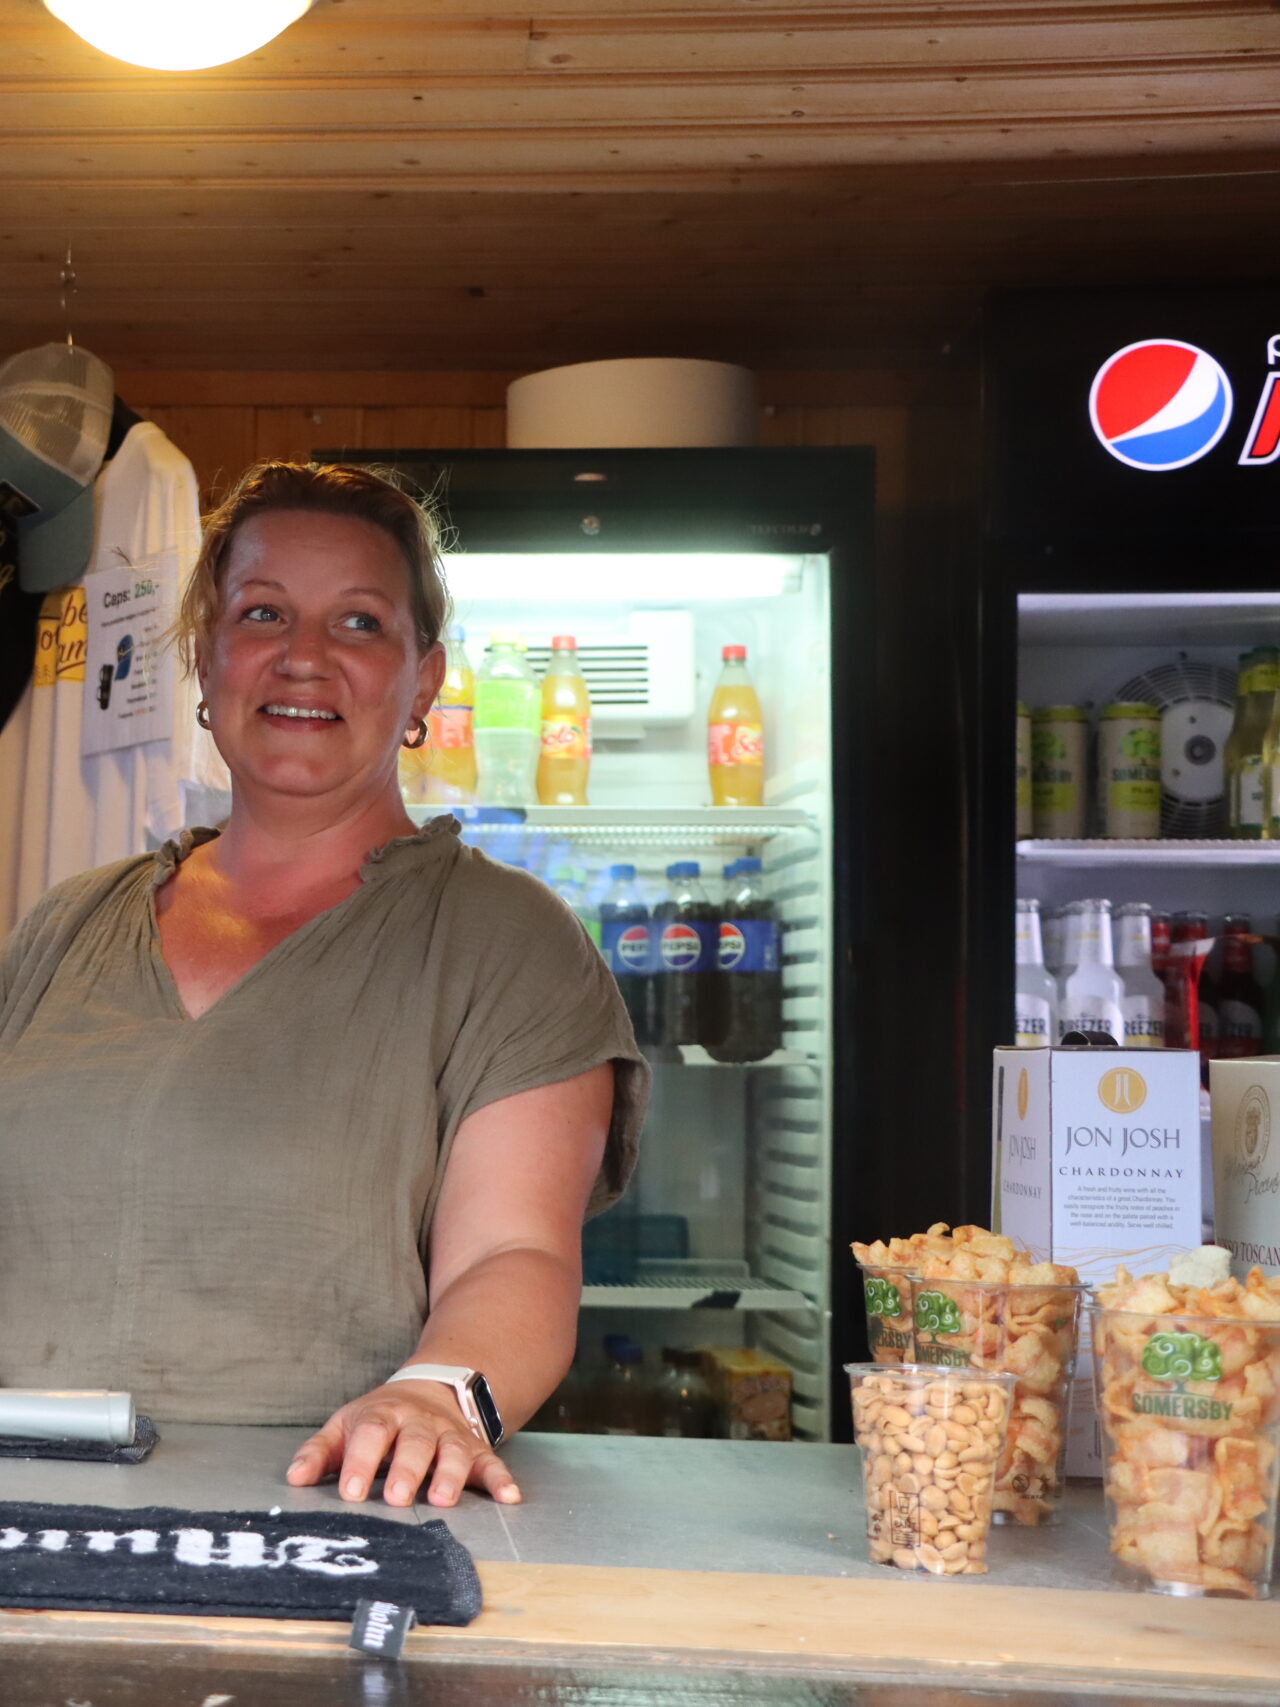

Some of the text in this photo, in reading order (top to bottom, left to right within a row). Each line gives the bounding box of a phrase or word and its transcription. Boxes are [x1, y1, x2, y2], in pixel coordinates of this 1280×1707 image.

[104, 590, 131, 609] Caps:
[719, 940, 742, 950] EPSI
[1064, 1126, 1181, 1157] JON JOSH
[1059, 1166, 1185, 1179] CHARDONNAY
[1132, 1393, 1233, 1421] SOMERSBY
